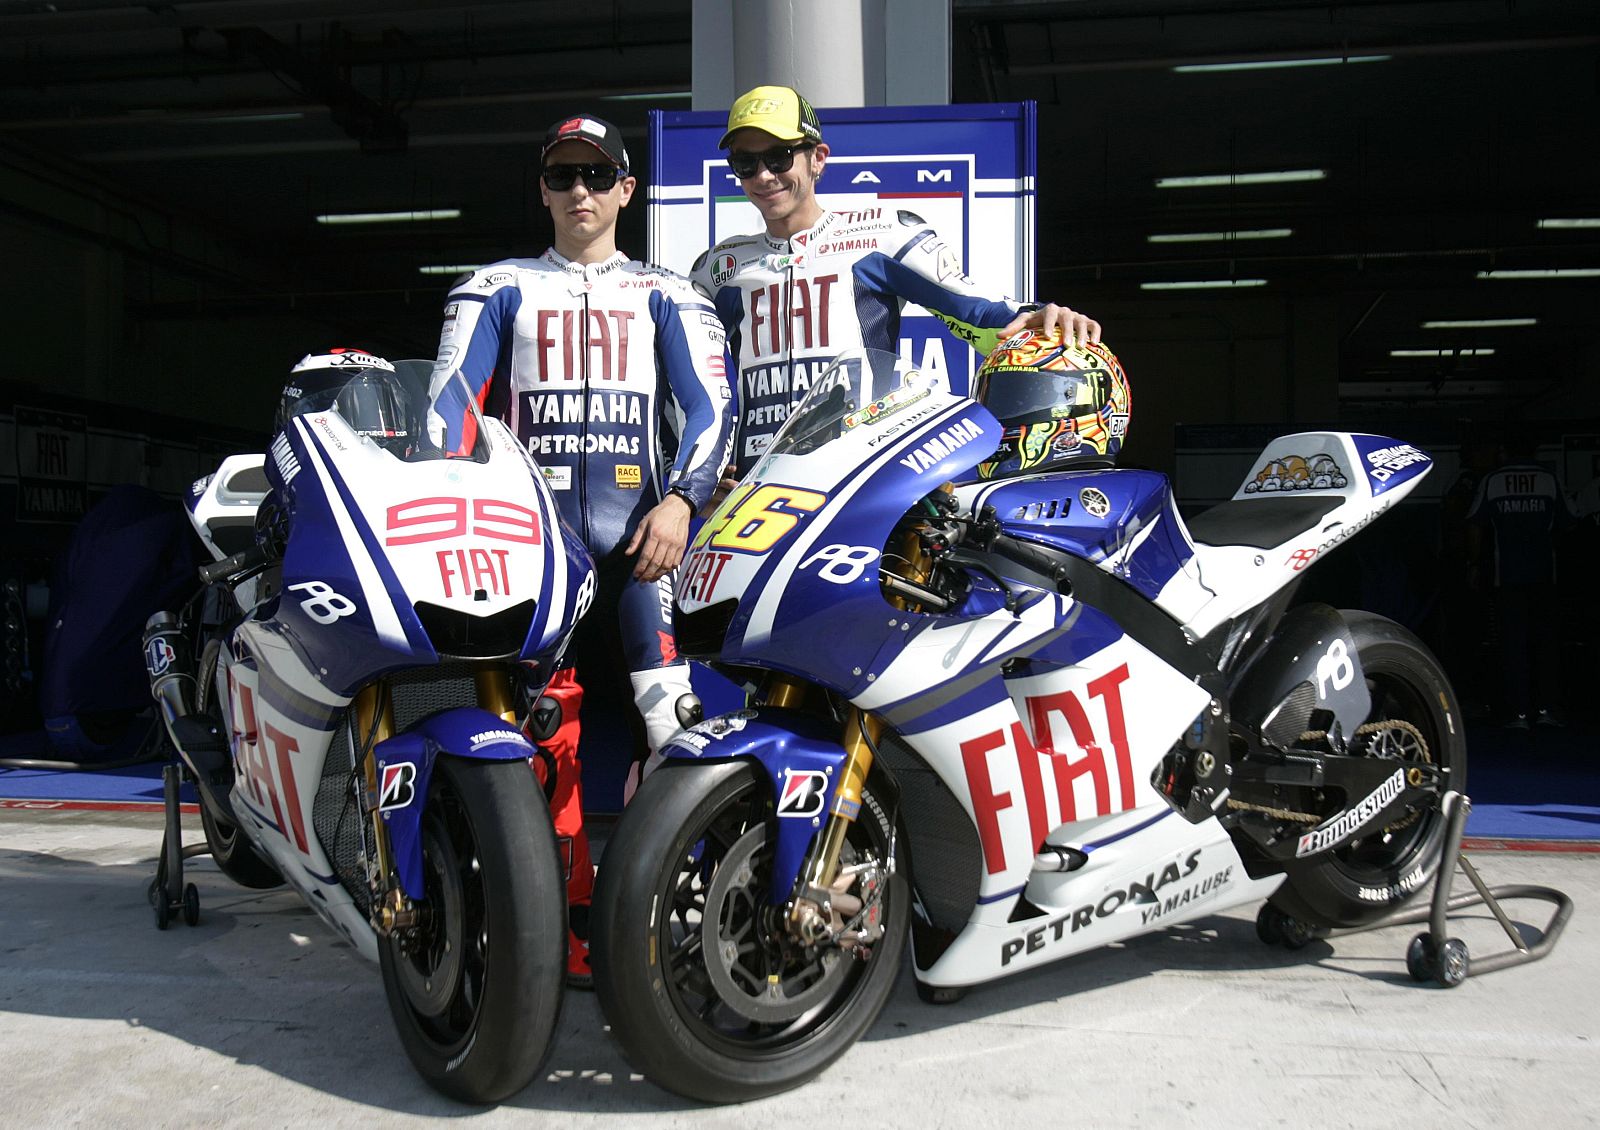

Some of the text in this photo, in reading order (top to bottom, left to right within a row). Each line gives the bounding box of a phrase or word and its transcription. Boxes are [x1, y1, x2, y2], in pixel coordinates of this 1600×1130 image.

[595, 258, 626, 276] YAMAHA
[832, 238, 878, 253] YAMAHA
[749, 274, 839, 358] FIAT
[537, 308, 636, 383] FIAT
[746, 361, 852, 400] YAMAHA
[527, 393, 643, 426] YAMAHA
[271, 430, 302, 485] YAMAHA
[528, 433, 641, 456] PETRONAS
[900, 417, 985, 475] YAMAHA
[617, 467, 639, 477] RACC
[1504, 474, 1538, 493] FIAT
[1496, 498, 1547, 513] YAMAHA
[436, 548, 511, 599] FIAT
[677, 552, 734, 604] FIAT
[959, 662, 1137, 876] FIAT
[1296, 767, 1406, 859] BRIDGESTONE
[1000, 848, 1202, 968] PETRONAS
[1139, 865, 1234, 926] YAMALUBE
